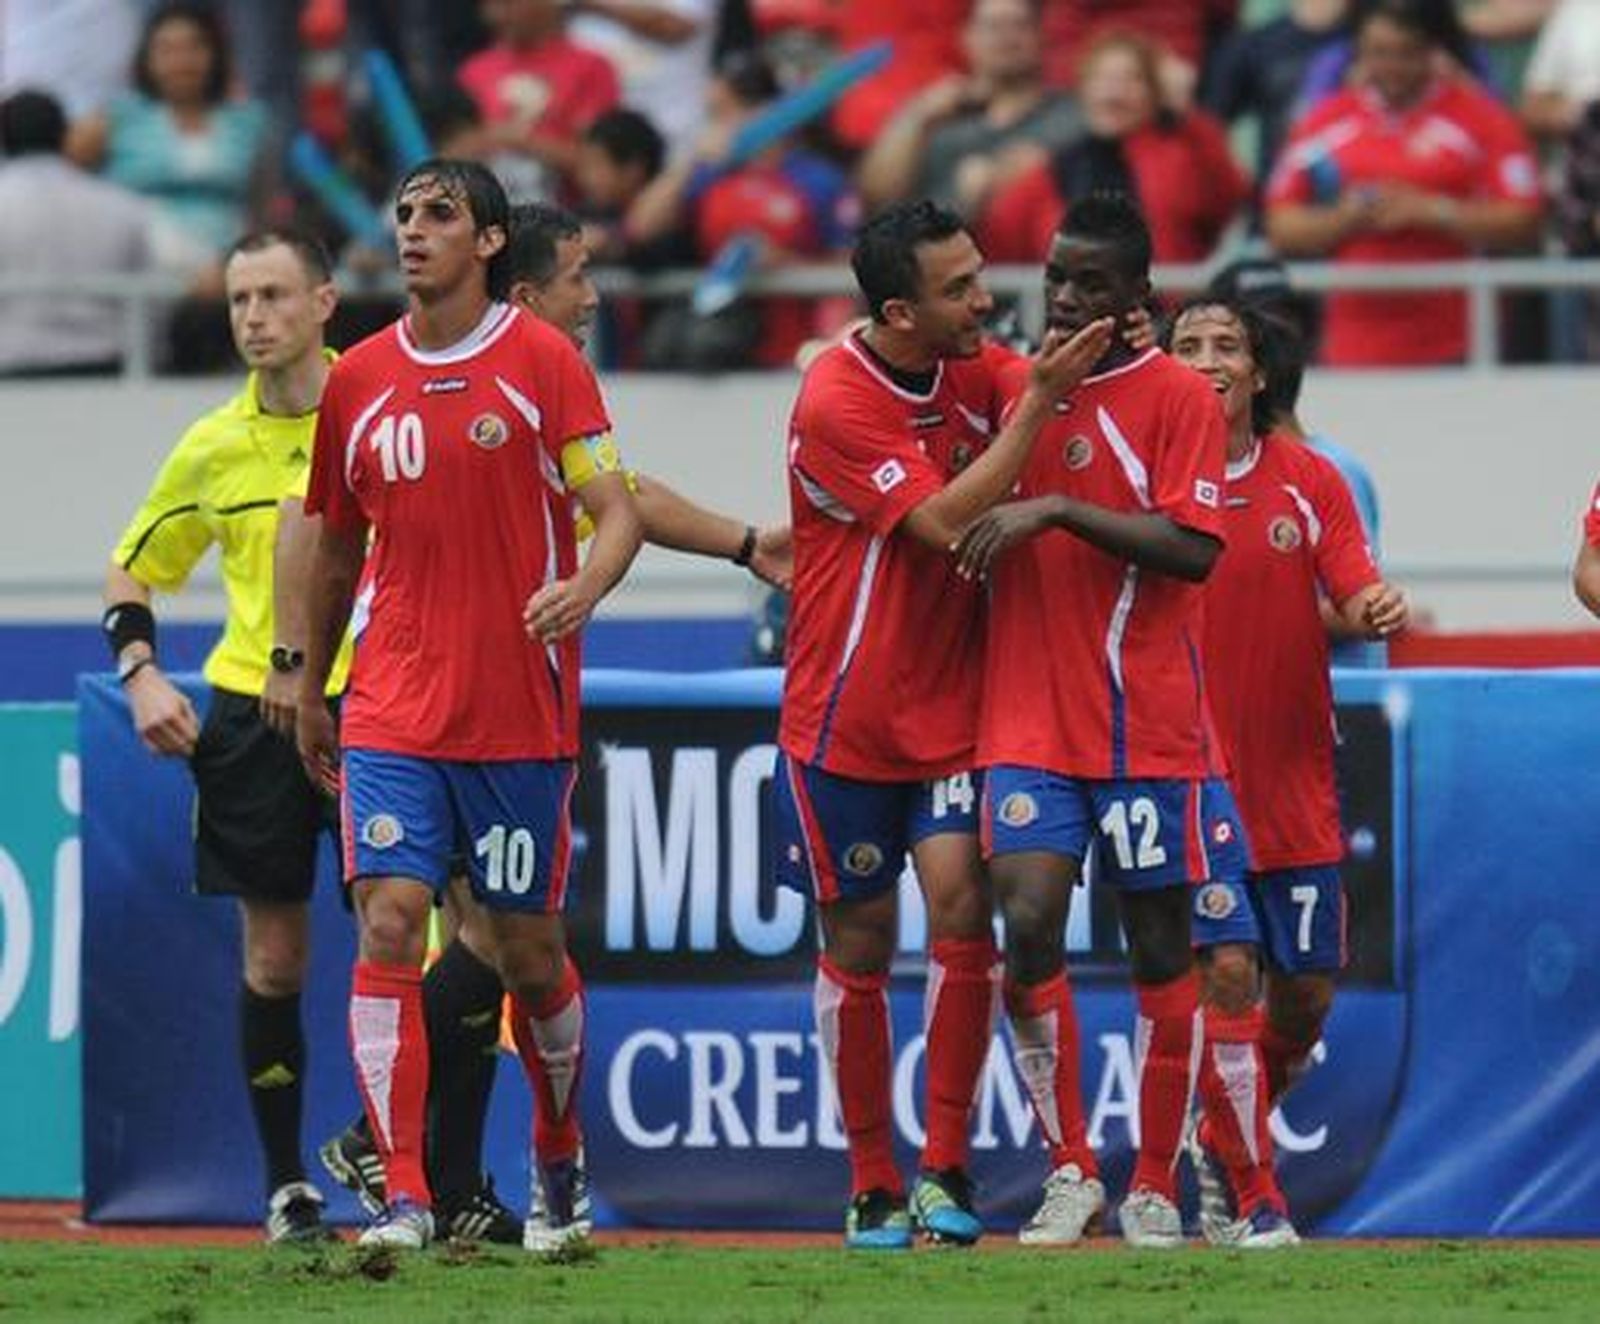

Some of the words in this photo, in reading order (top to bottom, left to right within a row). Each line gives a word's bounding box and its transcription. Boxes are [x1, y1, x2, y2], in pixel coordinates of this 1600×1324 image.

[370, 412, 426, 483] 10
[932, 770, 976, 820] 14
[475, 823, 536, 895] 10
[1100, 797, 1168, 870] 12
[1291, 884, 1319, 952] 7
